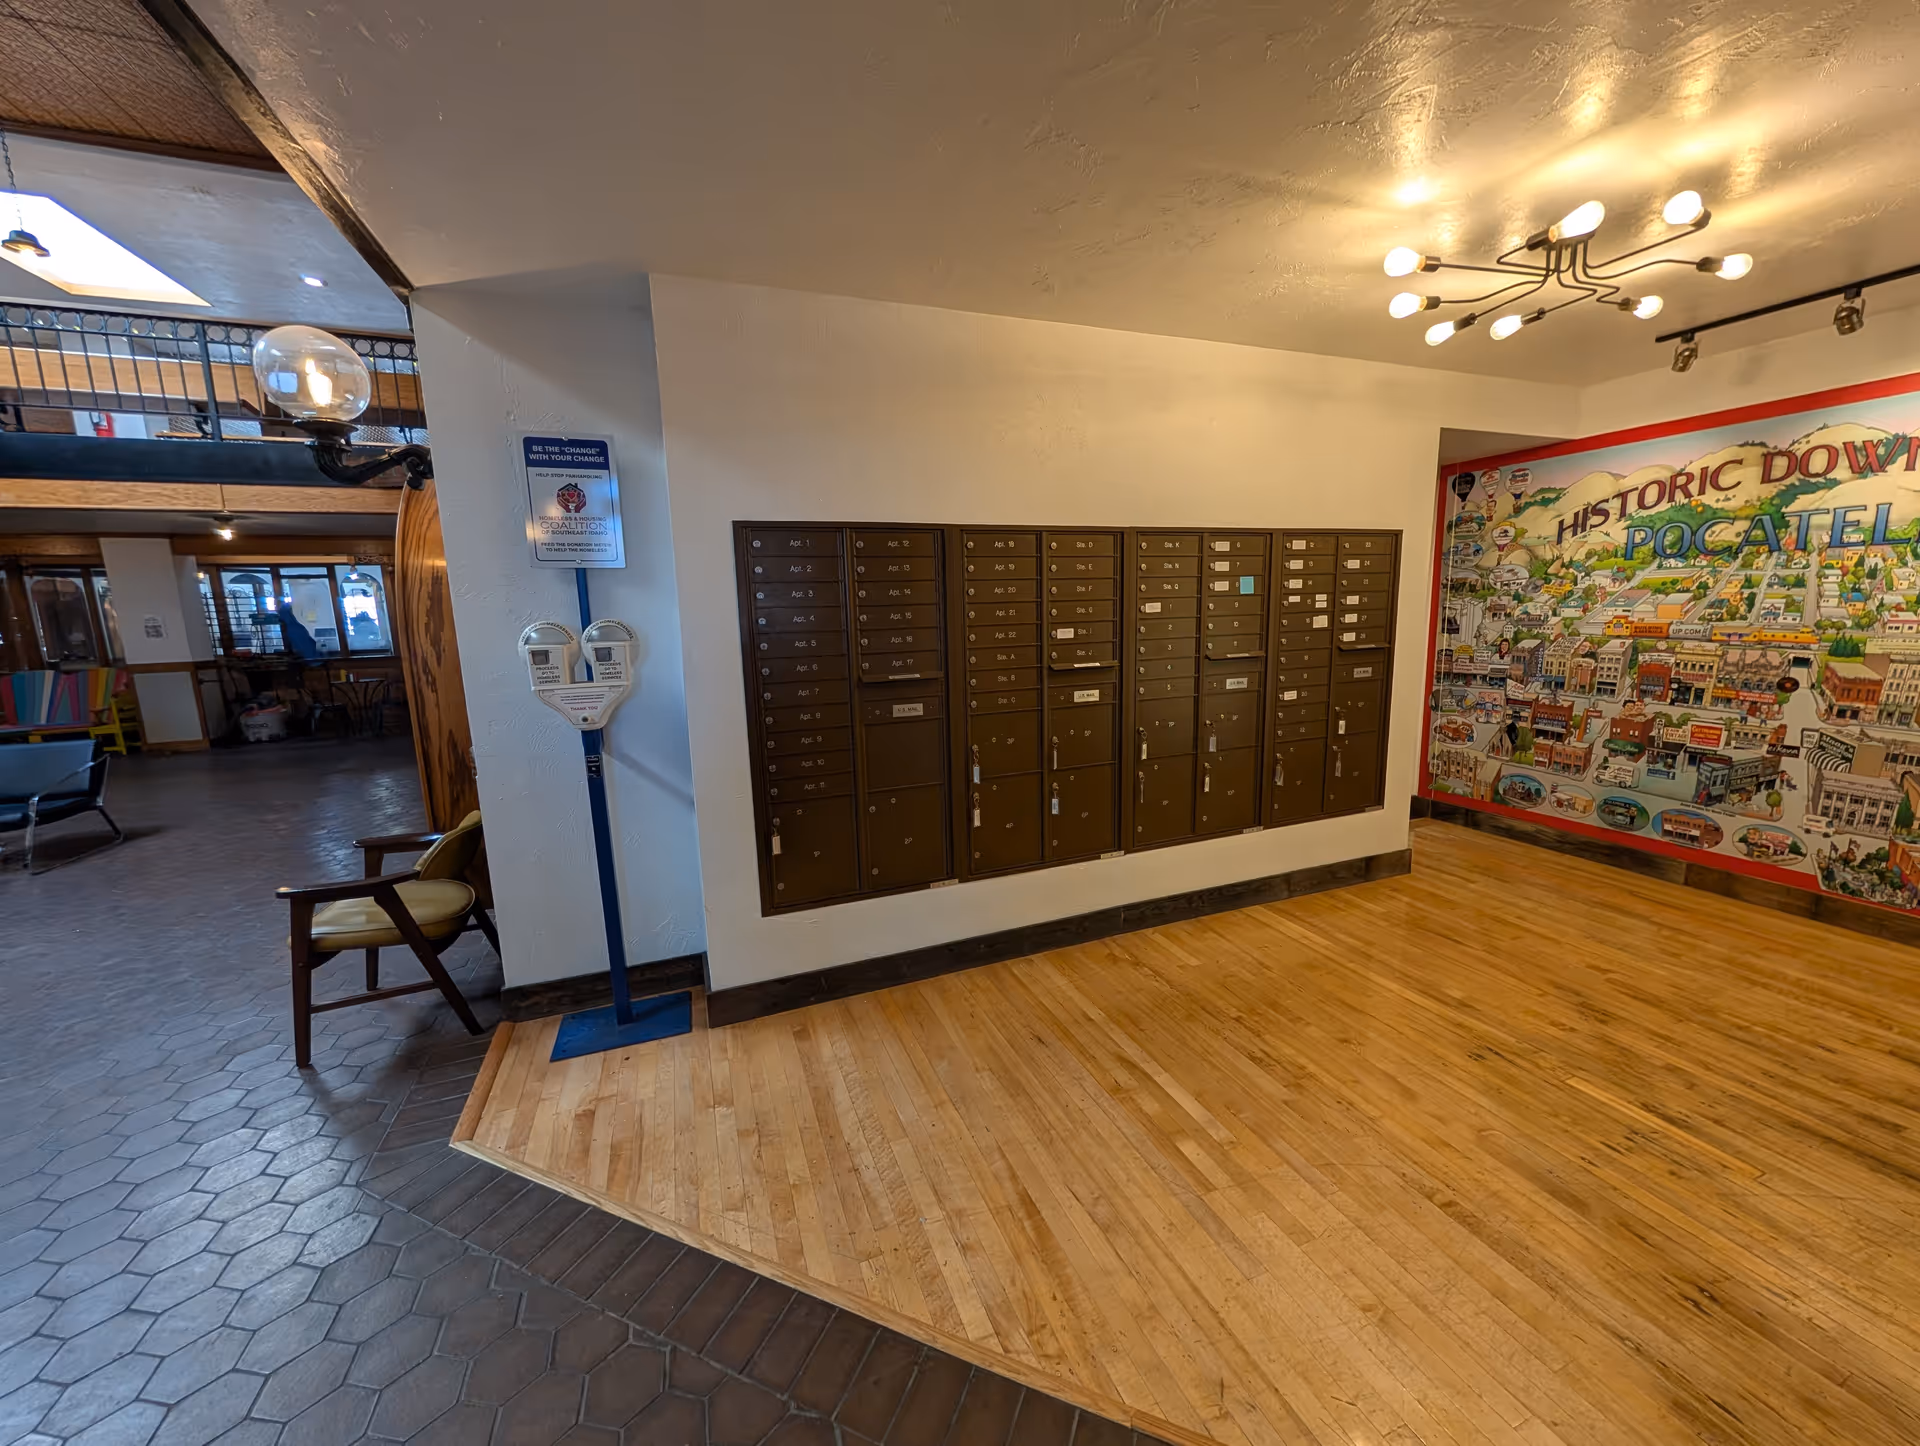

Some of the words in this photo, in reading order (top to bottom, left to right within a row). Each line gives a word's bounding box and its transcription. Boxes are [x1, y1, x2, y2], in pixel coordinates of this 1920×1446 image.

[540, 521, 607, 530] COALITION
[1556, 458, 1744, 545] HISTORIC
[1624, 503, 1920, 560] POCATEL
